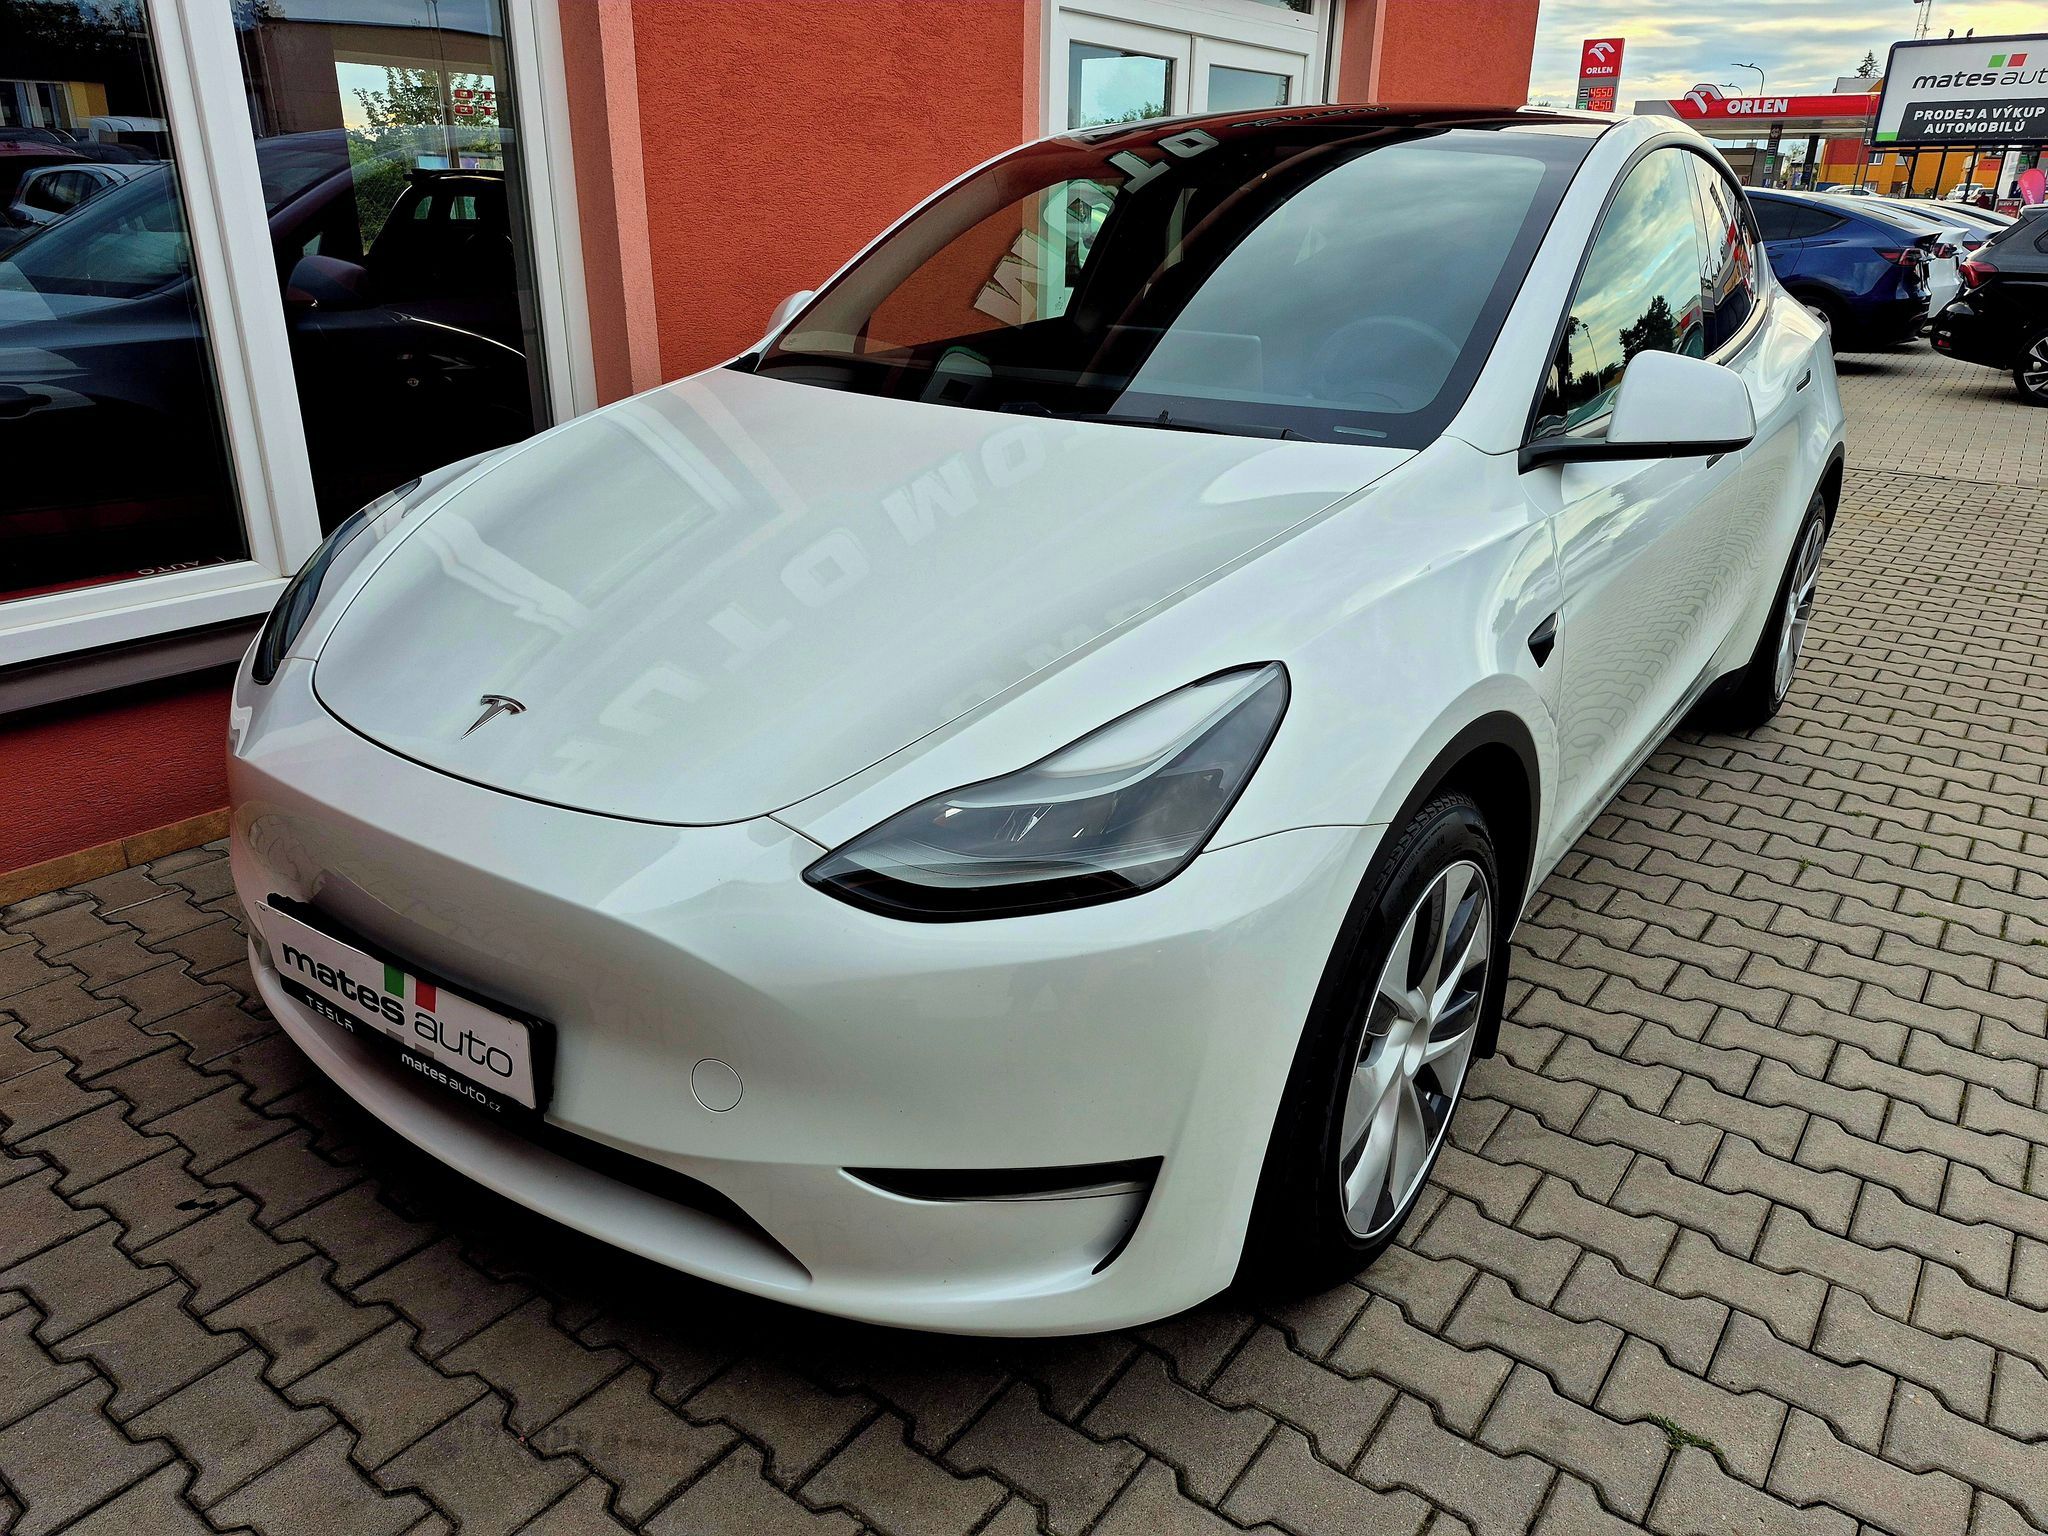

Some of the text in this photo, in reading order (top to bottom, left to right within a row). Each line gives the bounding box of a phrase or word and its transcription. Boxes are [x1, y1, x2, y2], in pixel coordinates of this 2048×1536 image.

[1586, 66, 1613, 74] ORLEN
[2000, 67, 2048, 85] aut
[1726, 98, 1789, 115] ORLEN
[1914, 104, 2046, 121] PRODEJ A VÝKUP
[305, 995, 354, 1034] TESLA
